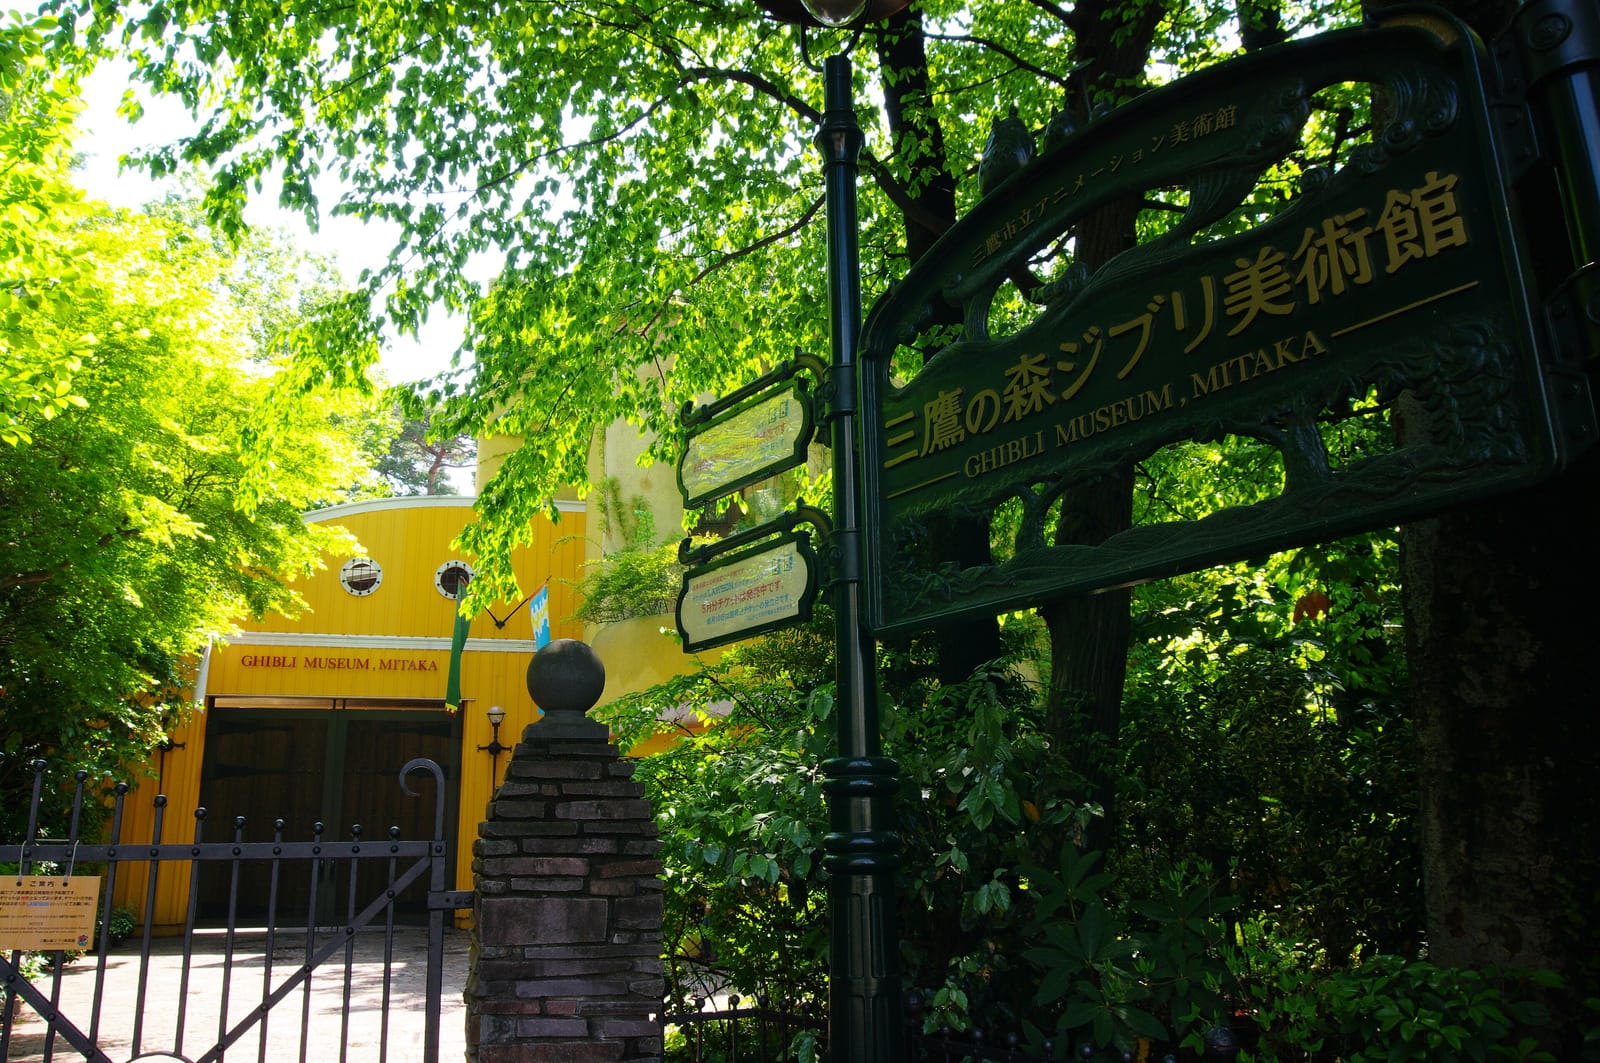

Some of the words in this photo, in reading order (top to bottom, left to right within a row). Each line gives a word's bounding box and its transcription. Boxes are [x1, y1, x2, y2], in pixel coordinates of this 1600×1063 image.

[971, 104, 1238, 268] 三鷹市立アニメーション美術館
[885, 171, 1468, 469] 三鷹の森ジブリ美術館
[965, 430, 1045, 479] GHIBLI
[1192, 330, 1328, 399] MITAKA
[241, 655, 297, 668] GHIBLI
[379, 659, 438, 672] MITAKA
